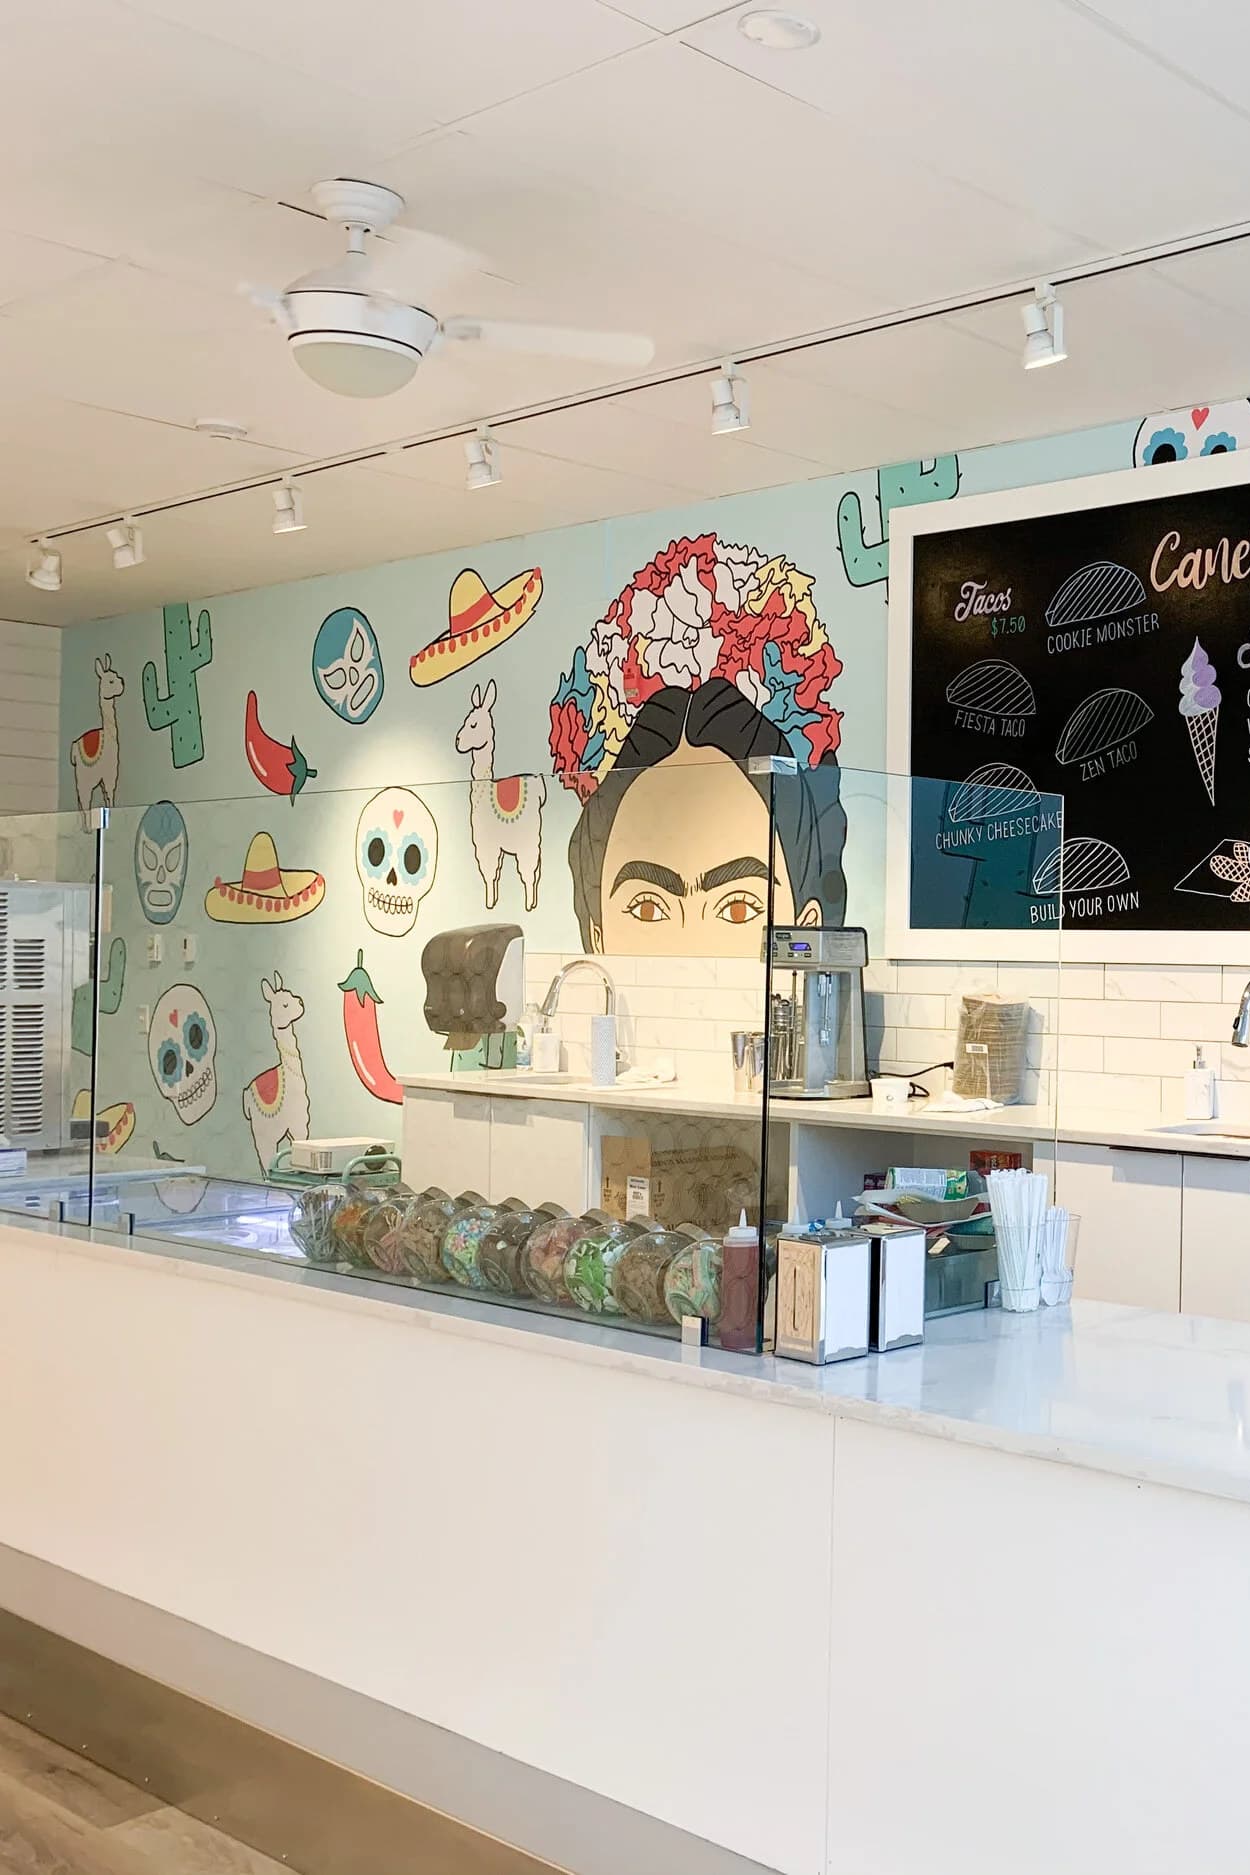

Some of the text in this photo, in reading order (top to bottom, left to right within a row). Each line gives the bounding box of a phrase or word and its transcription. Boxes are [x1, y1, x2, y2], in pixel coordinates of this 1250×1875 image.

[954, 580, 1012, 622] Tacos
[991, 615, 1026, 639] $7.50
[1047, 612, 1160, 654] COOKIE MONSTER
[954, 709, 1026, 737] FIESTA TACO
[1079, 741, 1138, 782] ZEN TACO
[935, 810, 1063, 850] CHUNKY CHEESECAKE
[1030, 891, 1140, 924] BUILD YOUR OWN
